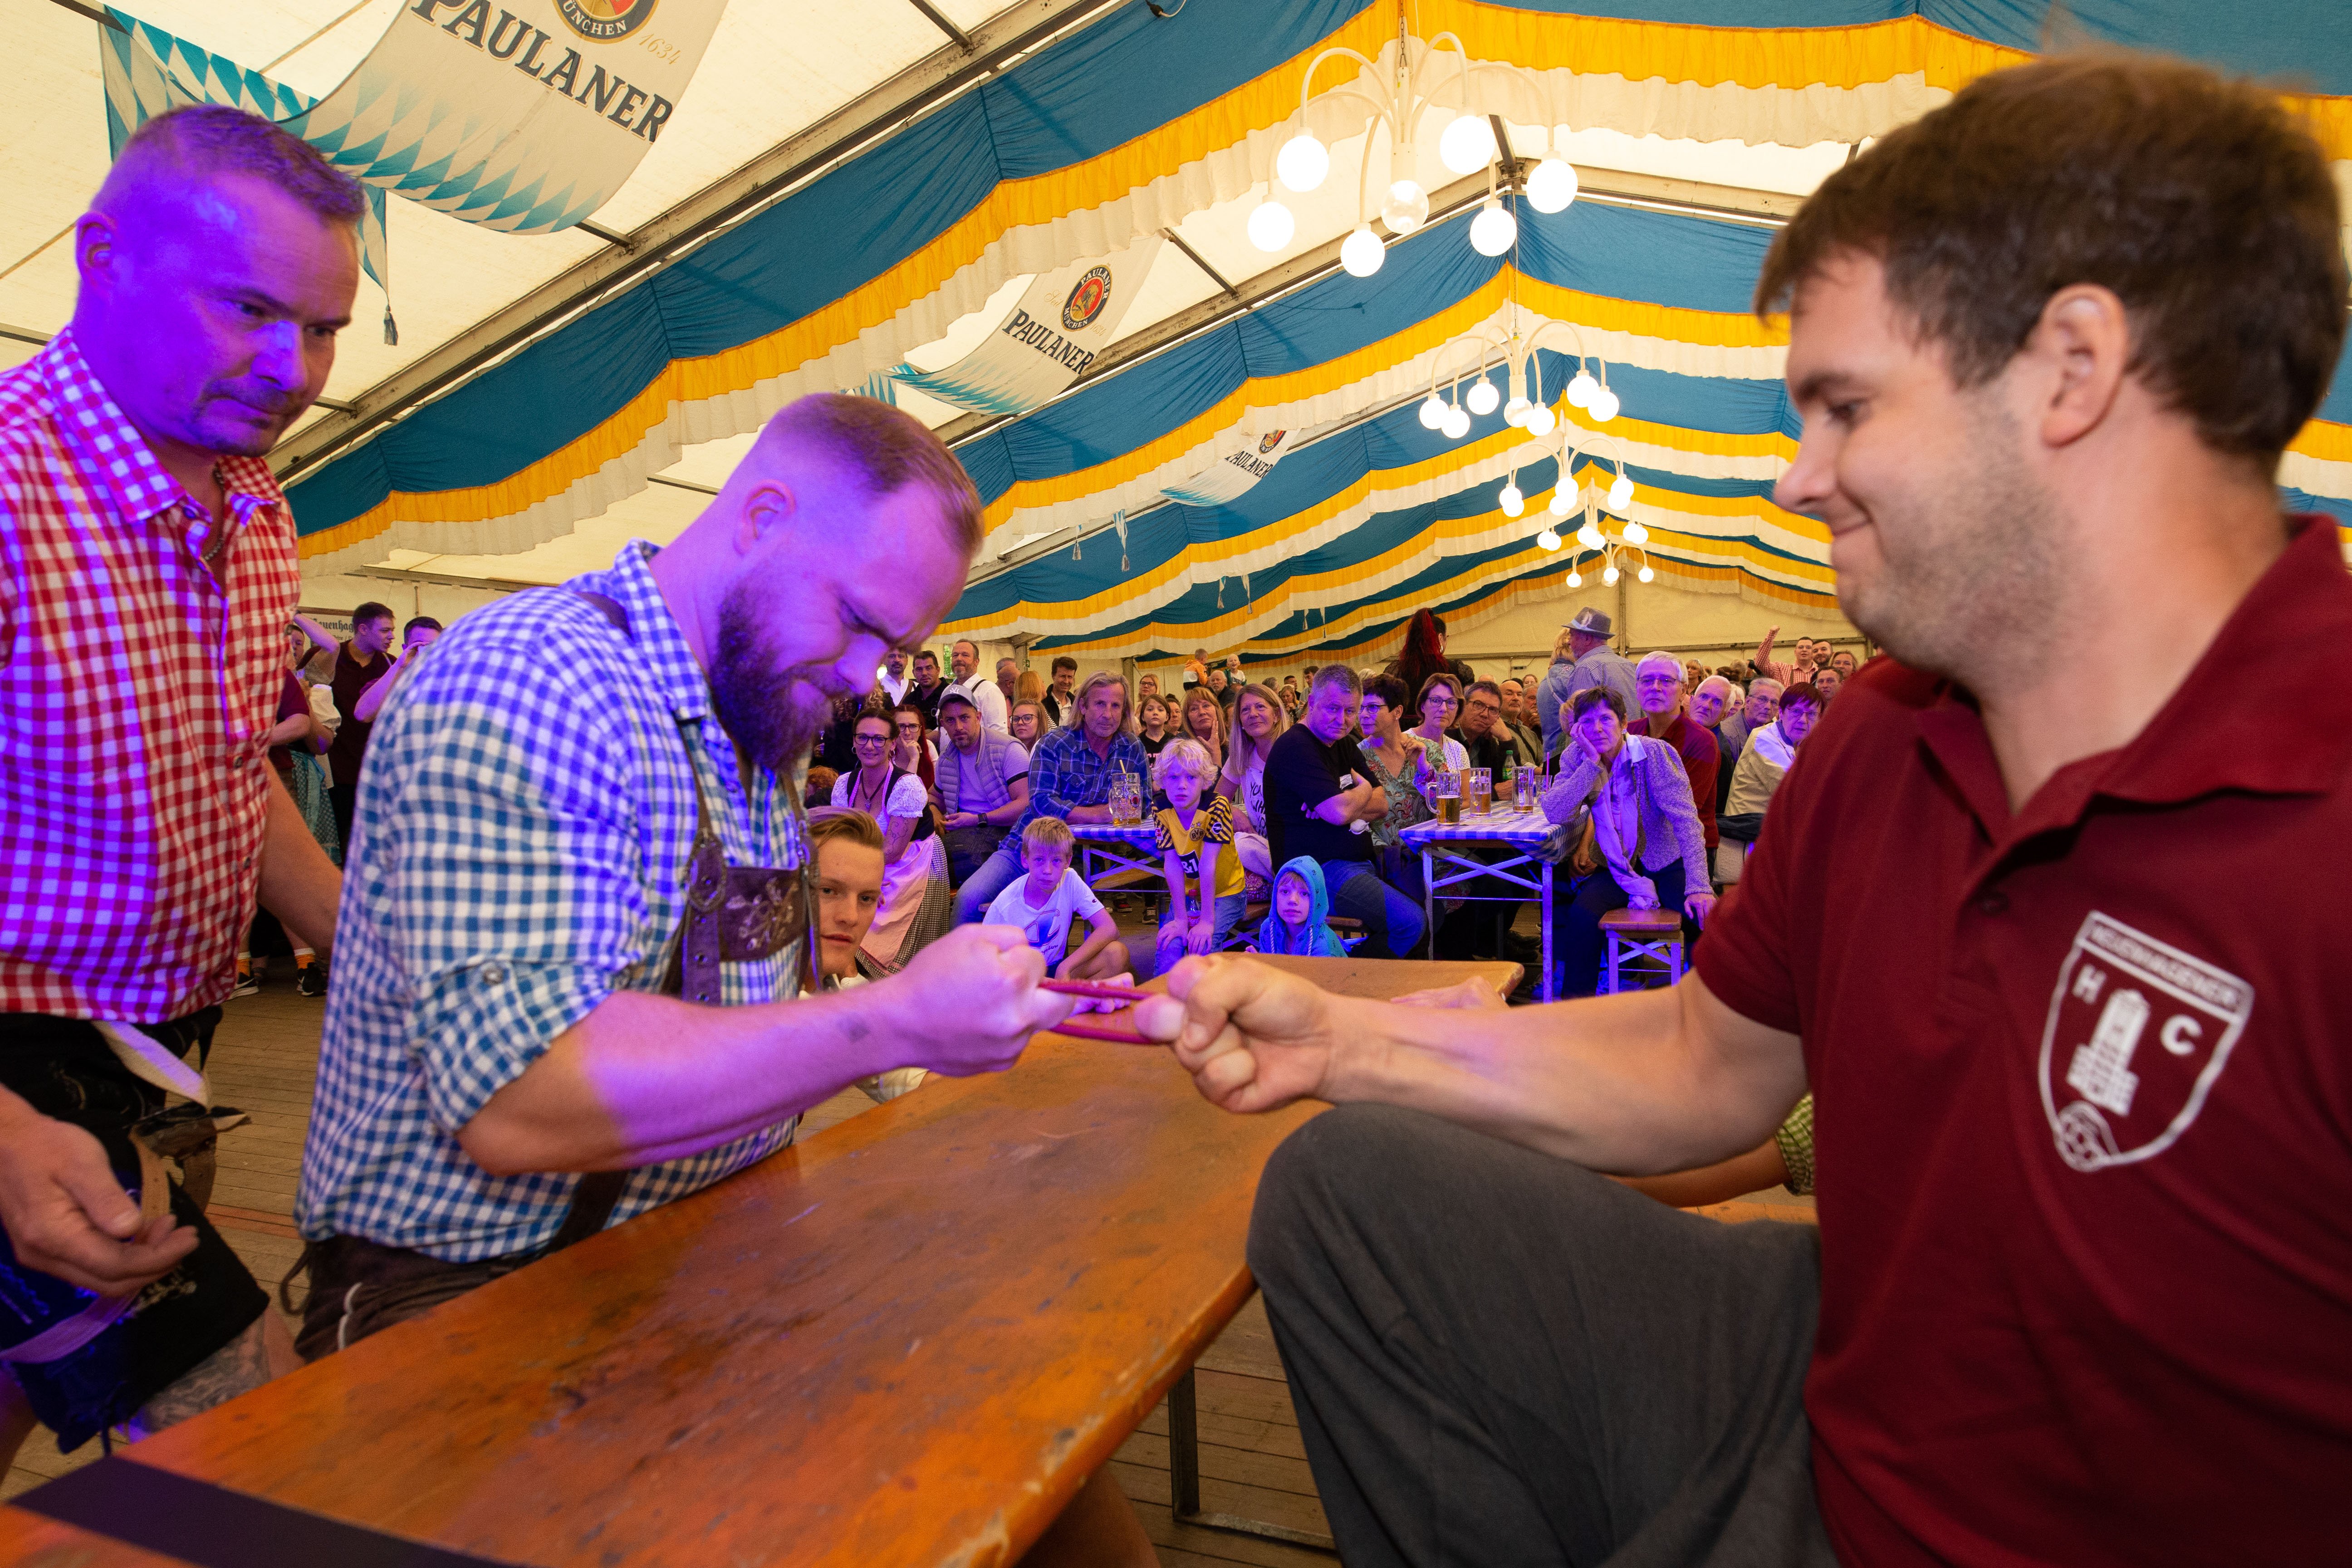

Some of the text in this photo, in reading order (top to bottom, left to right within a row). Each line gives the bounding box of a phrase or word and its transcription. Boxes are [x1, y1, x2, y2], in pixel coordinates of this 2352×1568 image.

[563, 0, 627, 35] ÜNCHEN
[639, 33, 681, 64] 1634
[1081, 268, 1110, 299] PAULANER
[1002, 308, 1095, 375] PAULANER
[1225, 451, 1274, 479] AULANER
[1191, 829, 1203, 839] BVB
[1181, 858, 1198, 873] &1
[2072, 964, 2107, 1004] H
[2160, 1014, 2203, 1056] C
